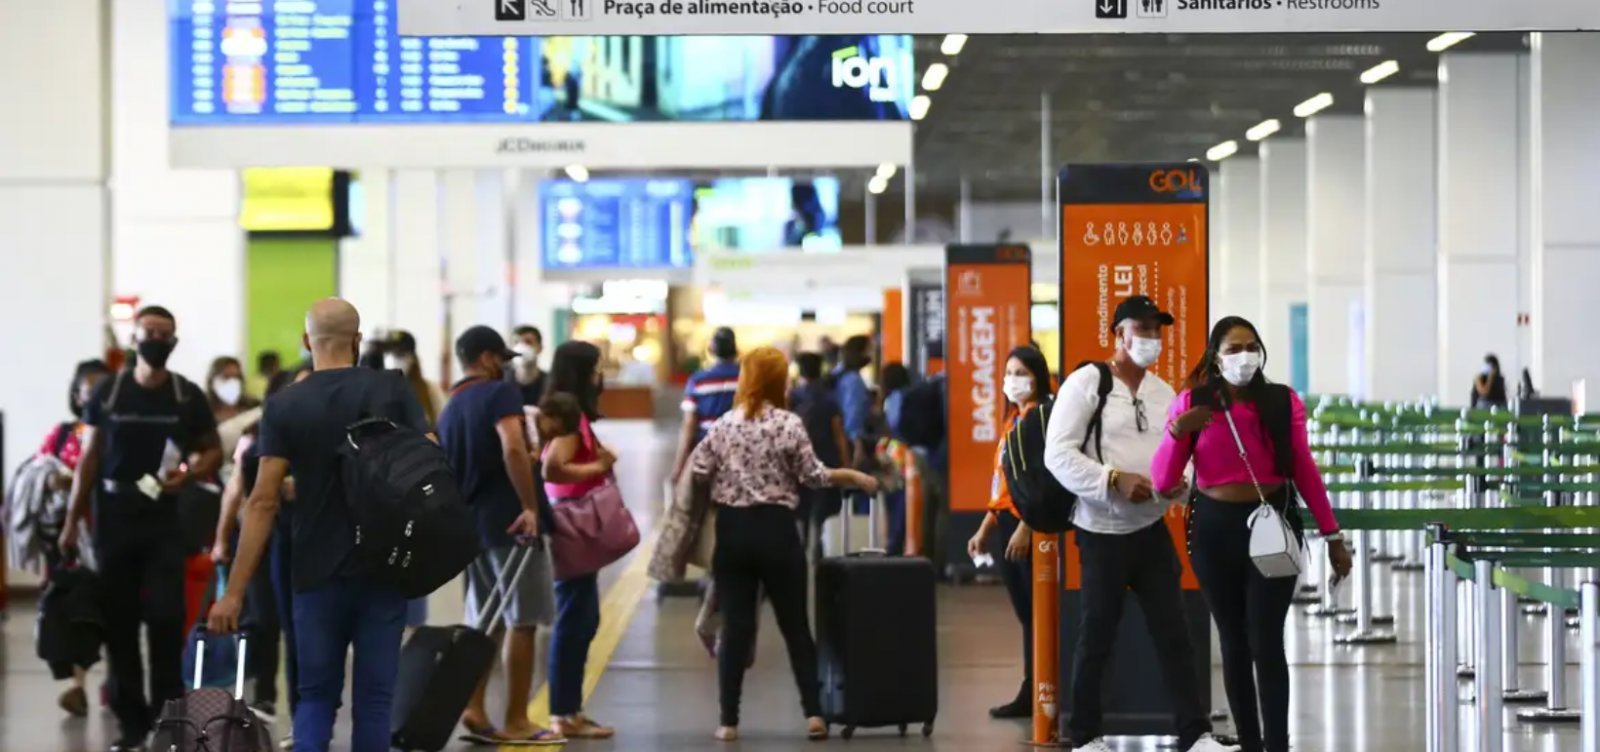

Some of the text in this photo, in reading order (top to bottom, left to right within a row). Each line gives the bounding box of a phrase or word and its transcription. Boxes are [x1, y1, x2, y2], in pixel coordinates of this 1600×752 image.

[604, 0, 654, 18] Praça
[660, 0, 683, 14] de
[818, 0, 862, 14] Food
[867, 0, 914, 14] court
[1287, 0, 1380, 10] Restrooms
[1149, 167, 1202, 192] GOL
[1114, 264, 1133, 297] LEI
[1137, 264, 1148, 297] pecial
[1097, 264, 1108, 348] atendimento
[971, 307, 996, 442] BAGAGEM
